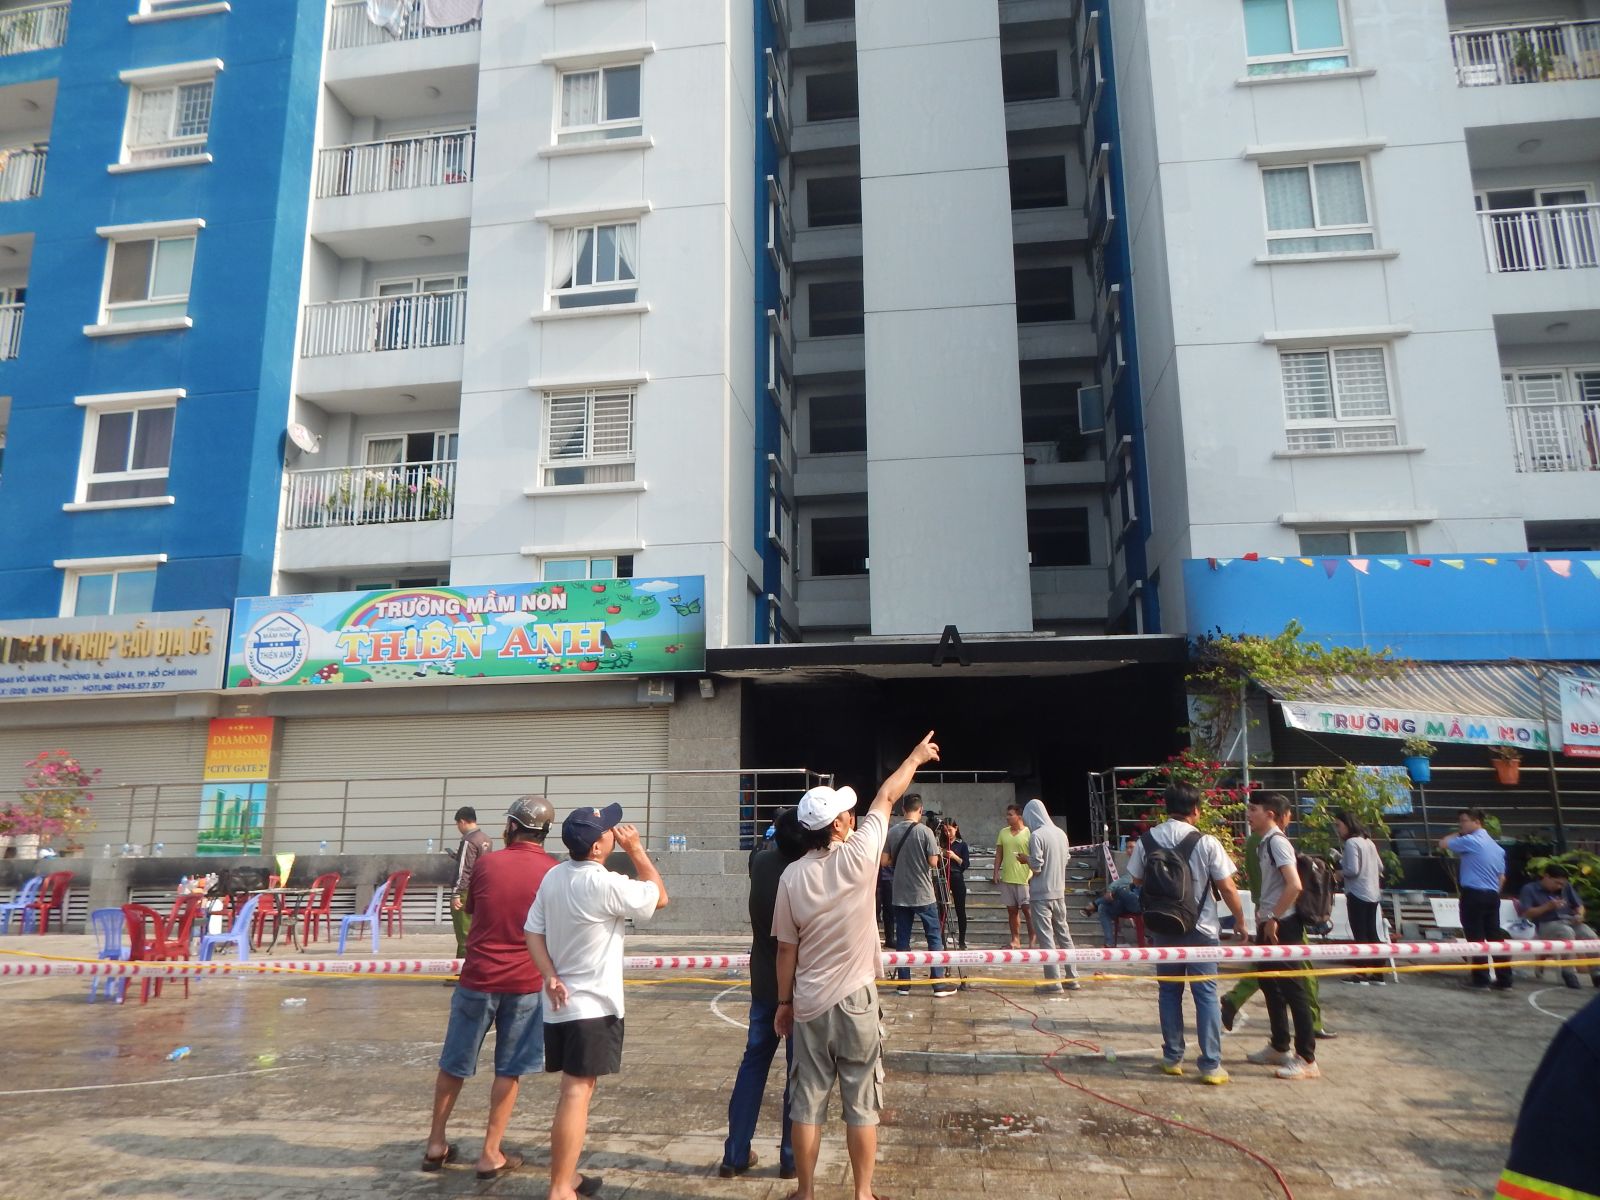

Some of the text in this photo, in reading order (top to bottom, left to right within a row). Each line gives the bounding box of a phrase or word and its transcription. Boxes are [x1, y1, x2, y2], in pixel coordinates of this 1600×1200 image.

[375, 589, 567, 619] TRƯỜNG MẦM NON
[120, 618, 153, 659] CẦU
[156, 628, 186, 664] ĐỊA
[498, 621, 607, 659] ANH
[932, 625, 970, 667] A
[104, 670, 126, 680] QUẬN
[148, 667, 160, 677] HỒ
[213, 734, 268, 745] DIAMOND
[1318, 712, 1548, 744] TRƯỜNG MẦM NON
[1570, 721, 1600, 736] Ngà
[233, 764, 257, 773] GATE
